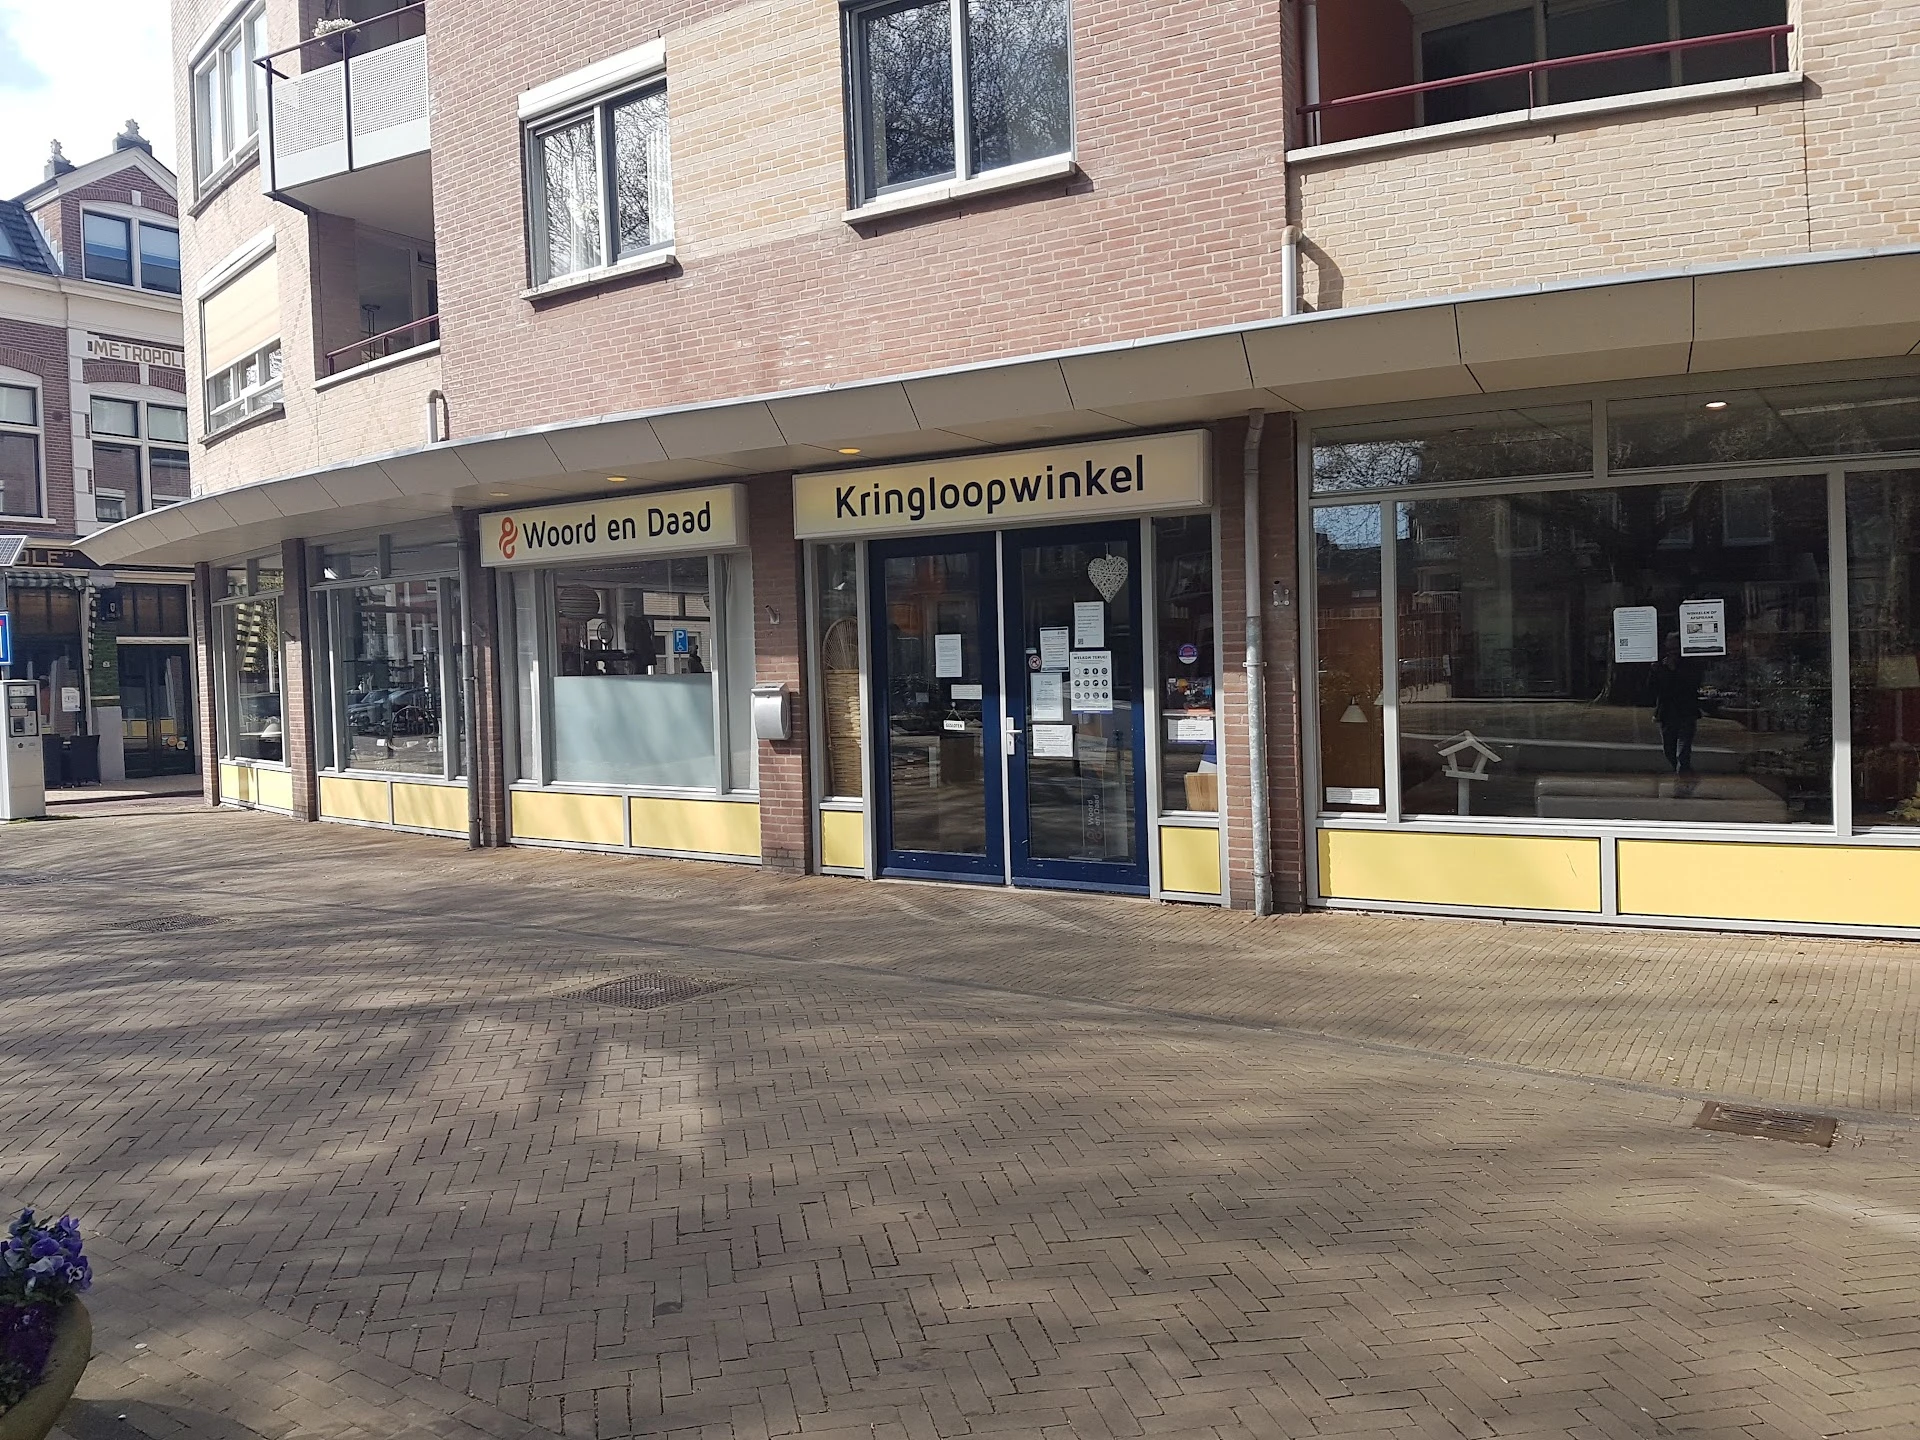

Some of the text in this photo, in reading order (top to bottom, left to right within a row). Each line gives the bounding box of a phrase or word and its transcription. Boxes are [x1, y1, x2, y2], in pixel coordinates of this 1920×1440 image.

[836, 454, 1144, 521] Kringloopwinkel
[522, 501, 711, 549] Woord en Daad
[676, 630, 685, 643] P
[1086, 799, 1095, 826] Woord
[1095, 816, 1101, 826] en
